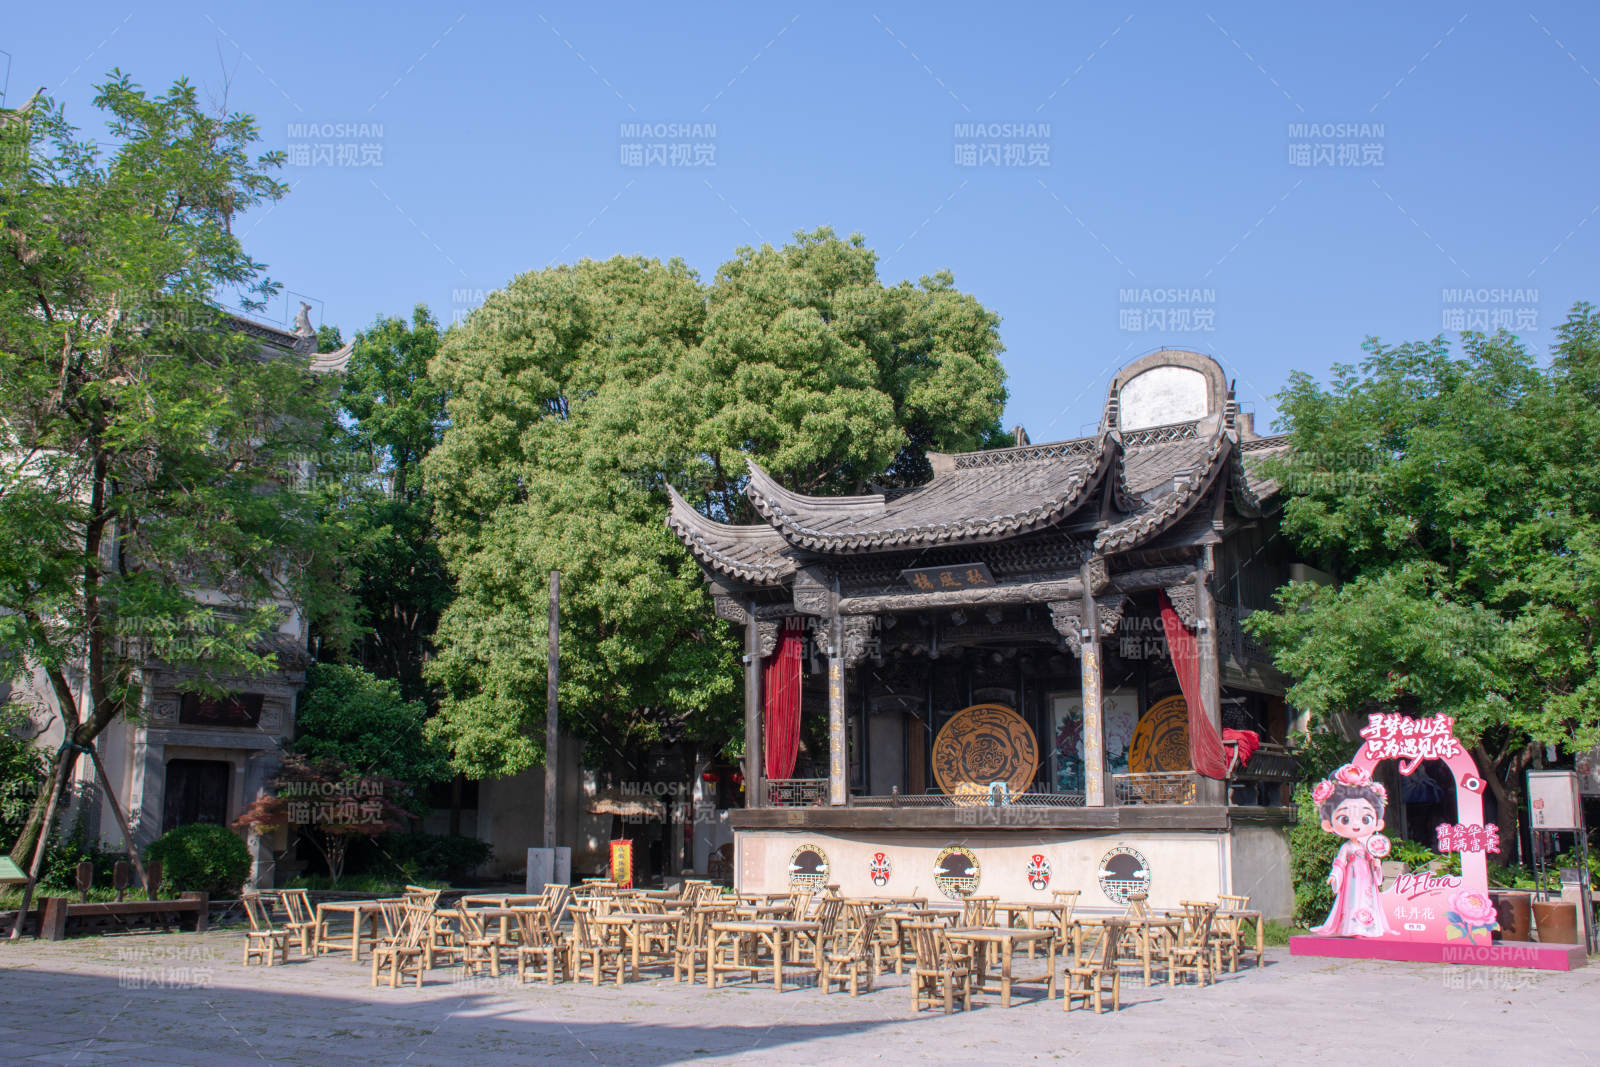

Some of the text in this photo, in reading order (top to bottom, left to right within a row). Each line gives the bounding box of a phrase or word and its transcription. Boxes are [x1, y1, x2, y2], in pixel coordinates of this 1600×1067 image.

[1360, 714, 1450, 739] 寻梦台儿庄
[1366, 735, 1460, 773] 只为遇见你
[1438, 824, 1497, 838] 雍容华贵
[1439, 838, 1497, 852] 圆满富贵
[1394, 905, 1436, 921] 牡丹花
